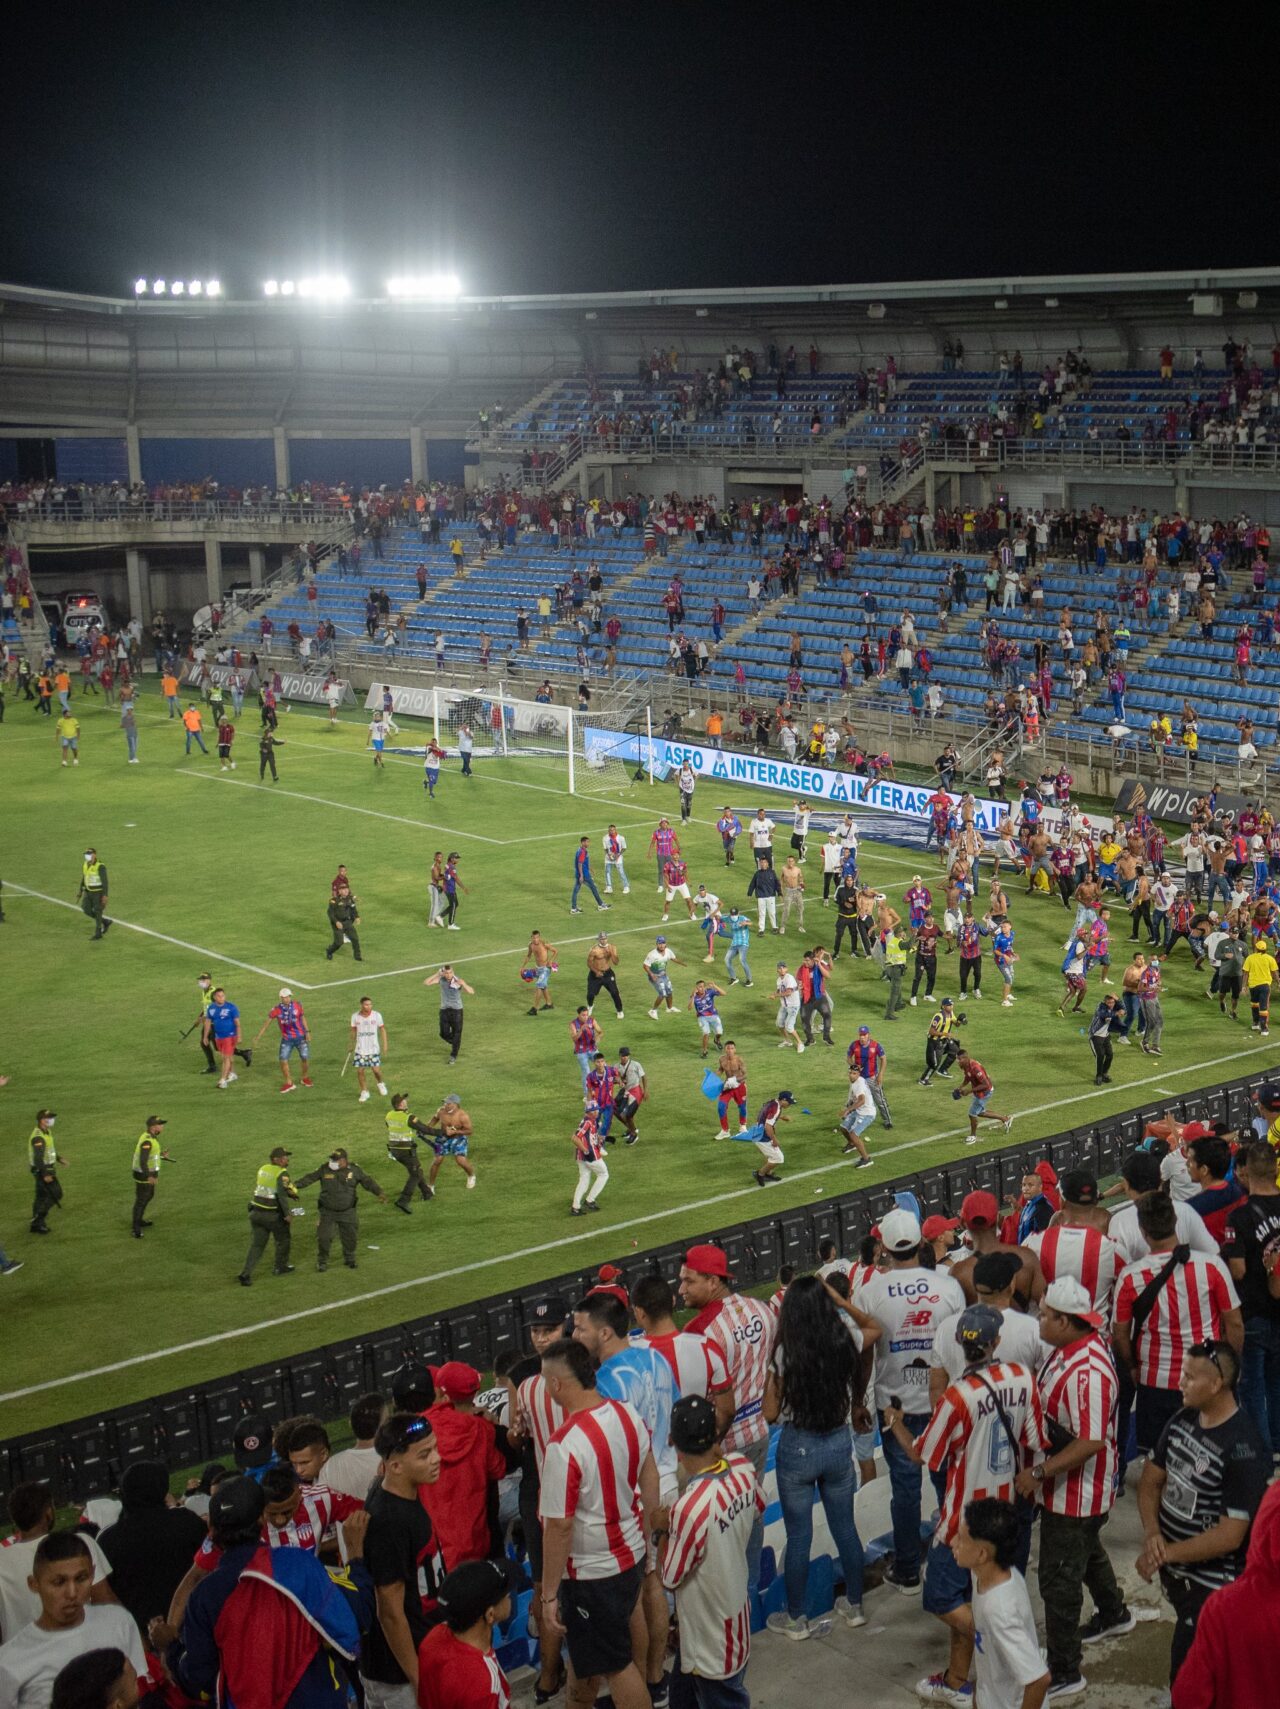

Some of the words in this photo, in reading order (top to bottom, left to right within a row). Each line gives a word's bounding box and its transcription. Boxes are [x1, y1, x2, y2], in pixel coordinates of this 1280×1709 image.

[665, 745, 704, 769] ASEO
[730, 757, 824, 793] INTERASEO
[851, 779, 934, 815] INTERAS
